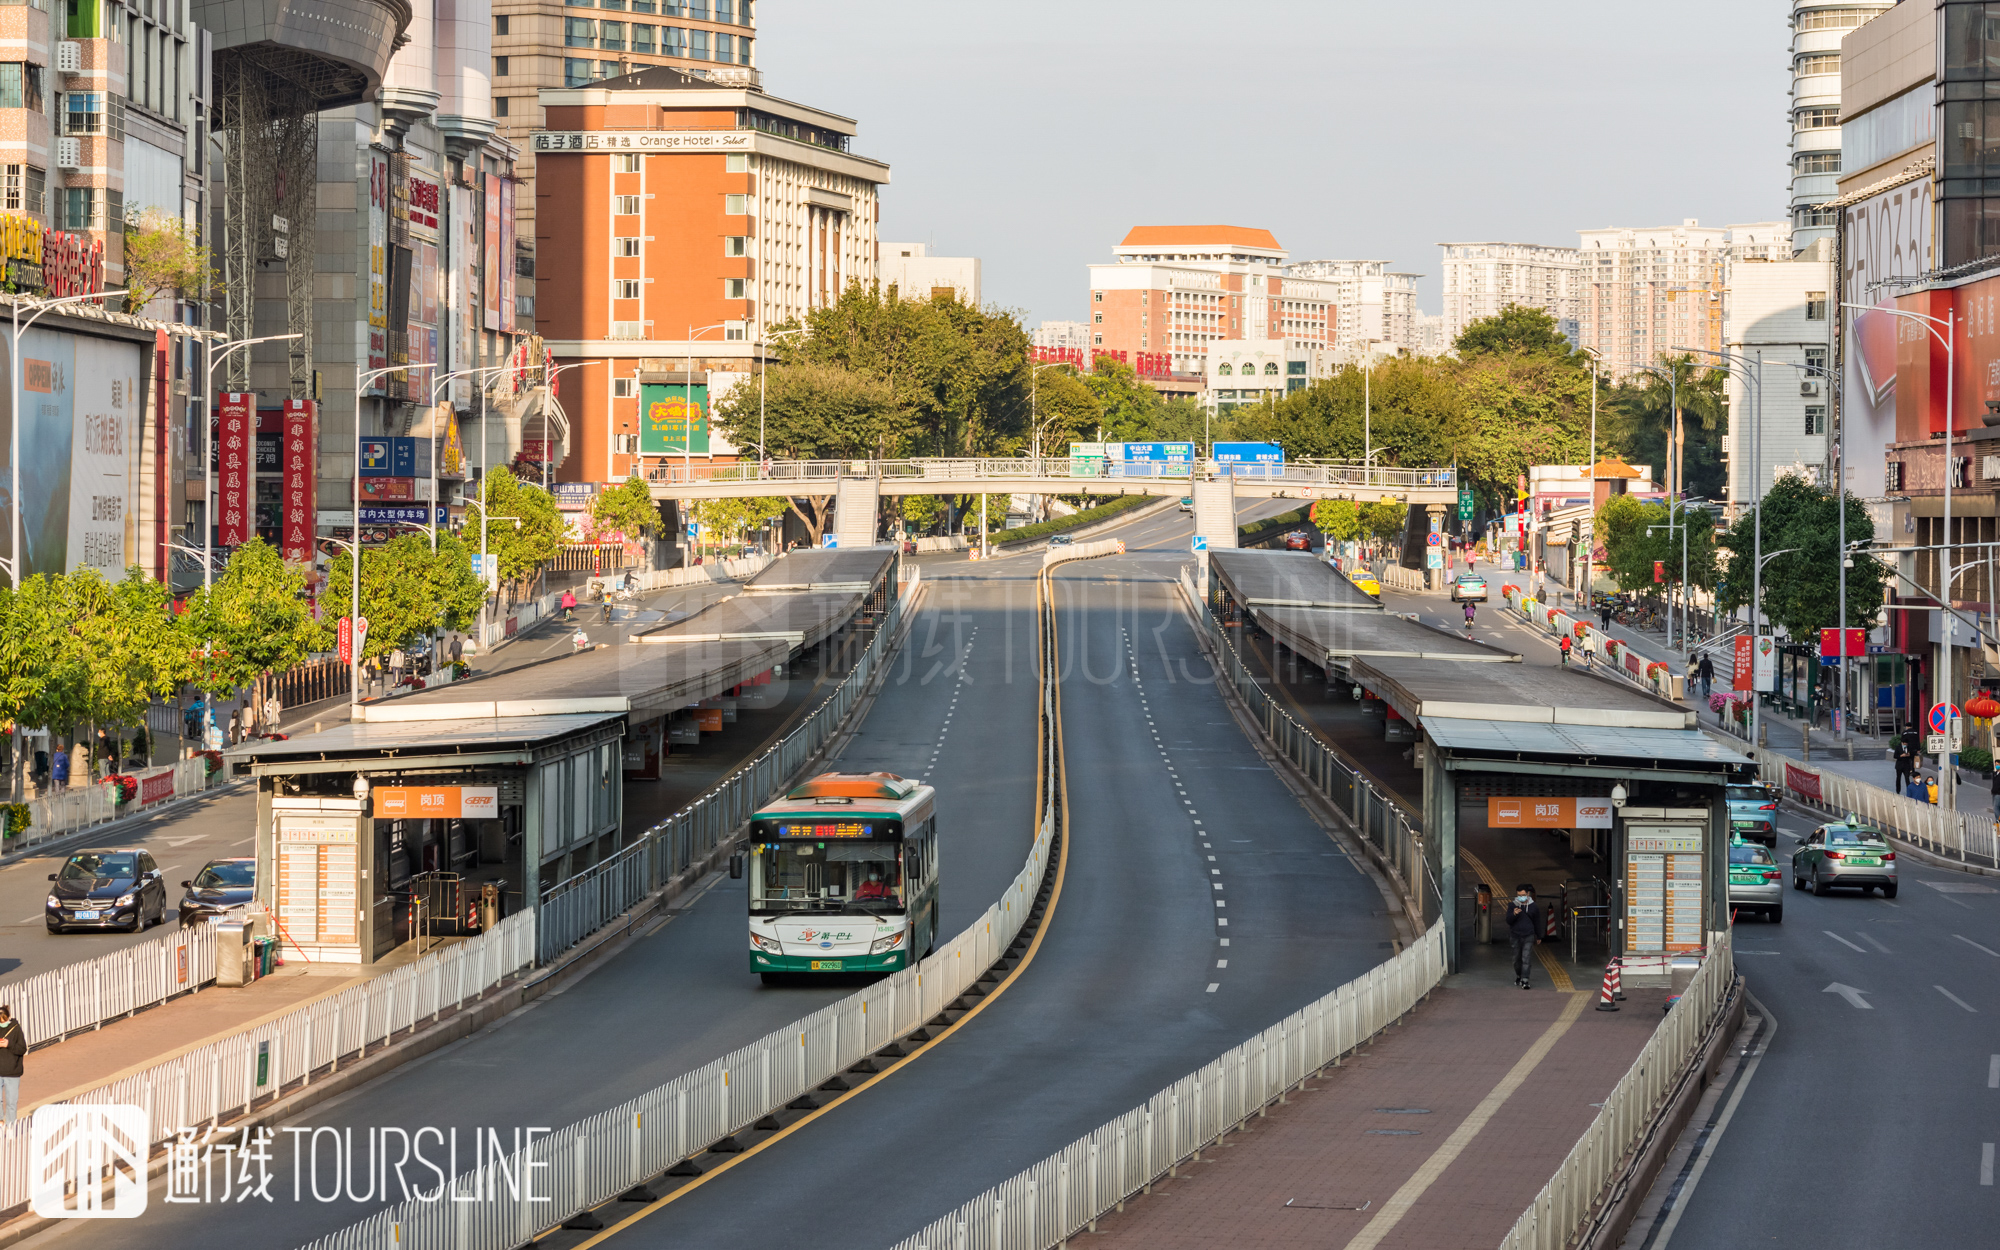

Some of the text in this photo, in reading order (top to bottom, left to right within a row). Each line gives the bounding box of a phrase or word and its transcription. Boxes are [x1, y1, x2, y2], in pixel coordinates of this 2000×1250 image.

[640, 135, 748, 146] Orange Hotel Select
[1136, 351, 1172, 376] 面向未来
[28, 364, 51, 388] OPPEIN
[85, 413, 123, 457] 欧派姚良松
[225, 419, 241, 545] 非你莫属贺新春
[290, 424, 304, 543] 非你莫属贺新春
[358, 510, 425, 519] 室内大型停车场
[437, 508, 445, 523] P
[420, 793, 445, 806] 岗顶
[1535, 804, 1559, 816] 岗顶
[820, 932, 853, 940] 第一巴士
